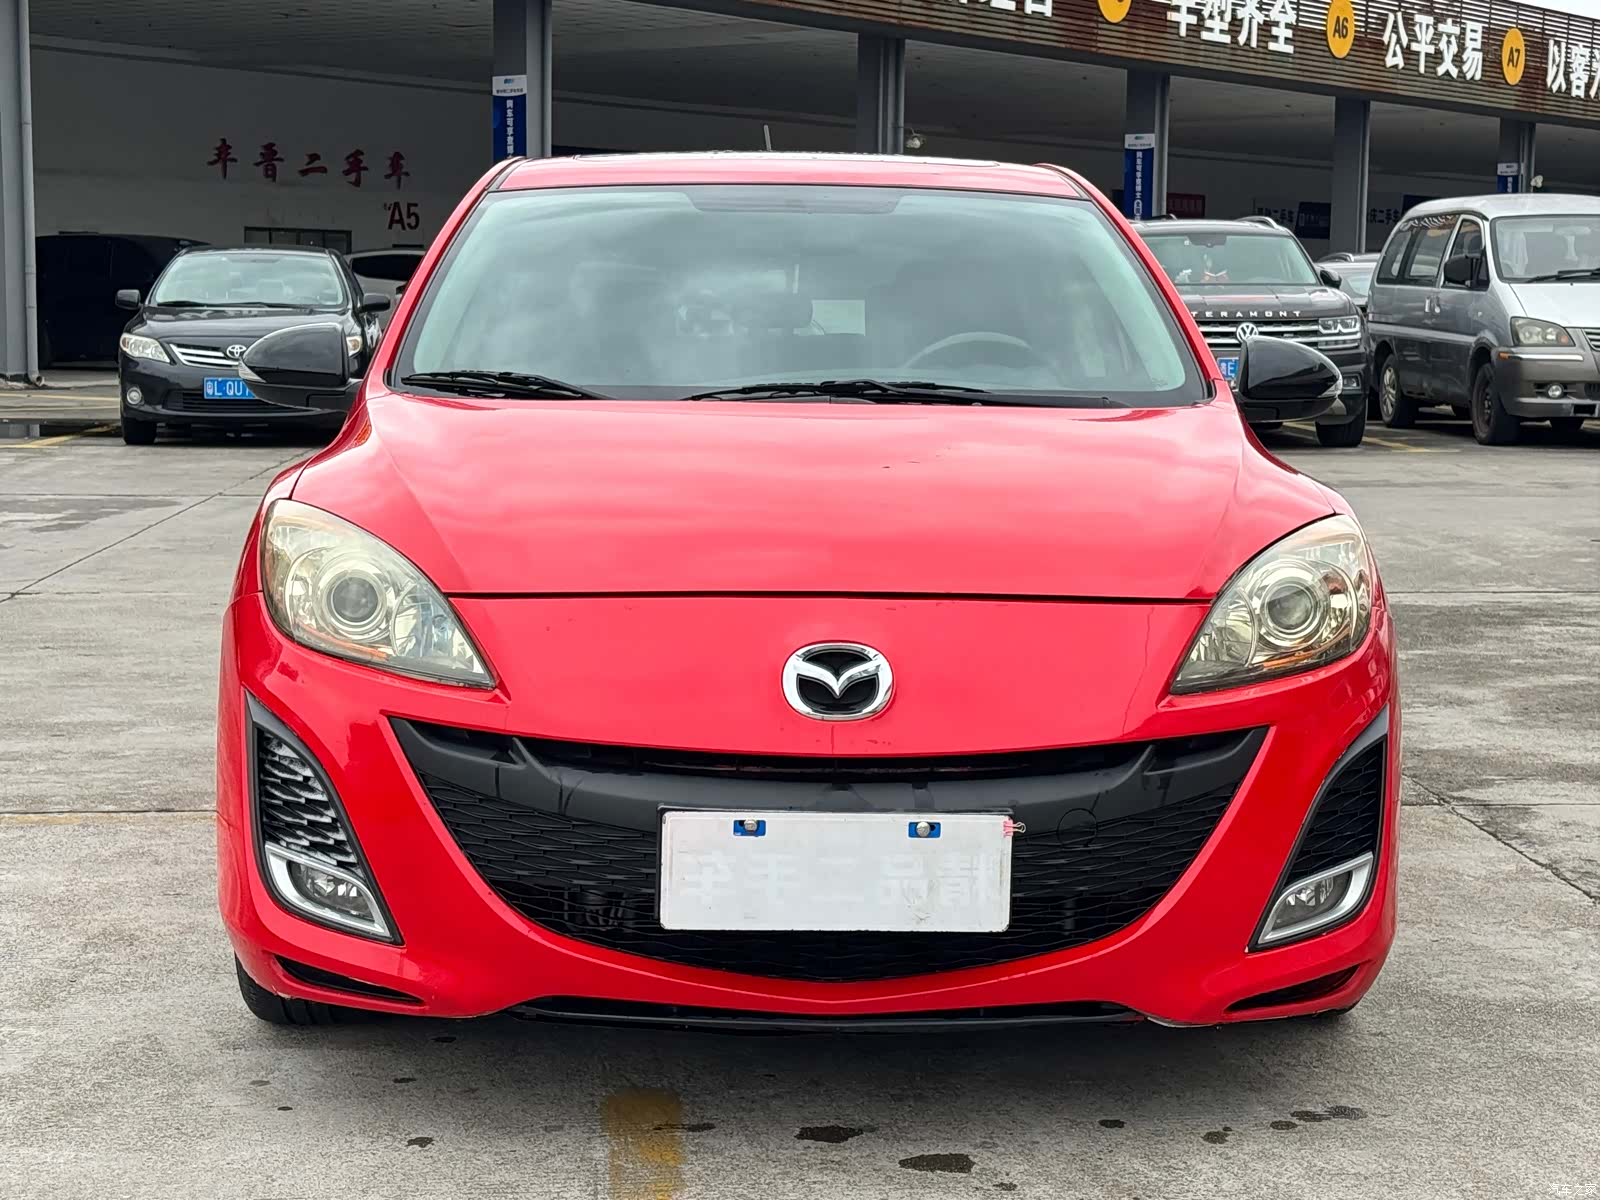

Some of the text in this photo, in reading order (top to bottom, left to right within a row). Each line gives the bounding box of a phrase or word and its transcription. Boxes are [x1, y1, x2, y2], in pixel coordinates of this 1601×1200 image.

[1333, 16, 1349, 39] A6
[1383, 11, 1483, 81] 公平交易
[1507, 43, 1521, 70] A7
[388, 201, 420, 231] A5
